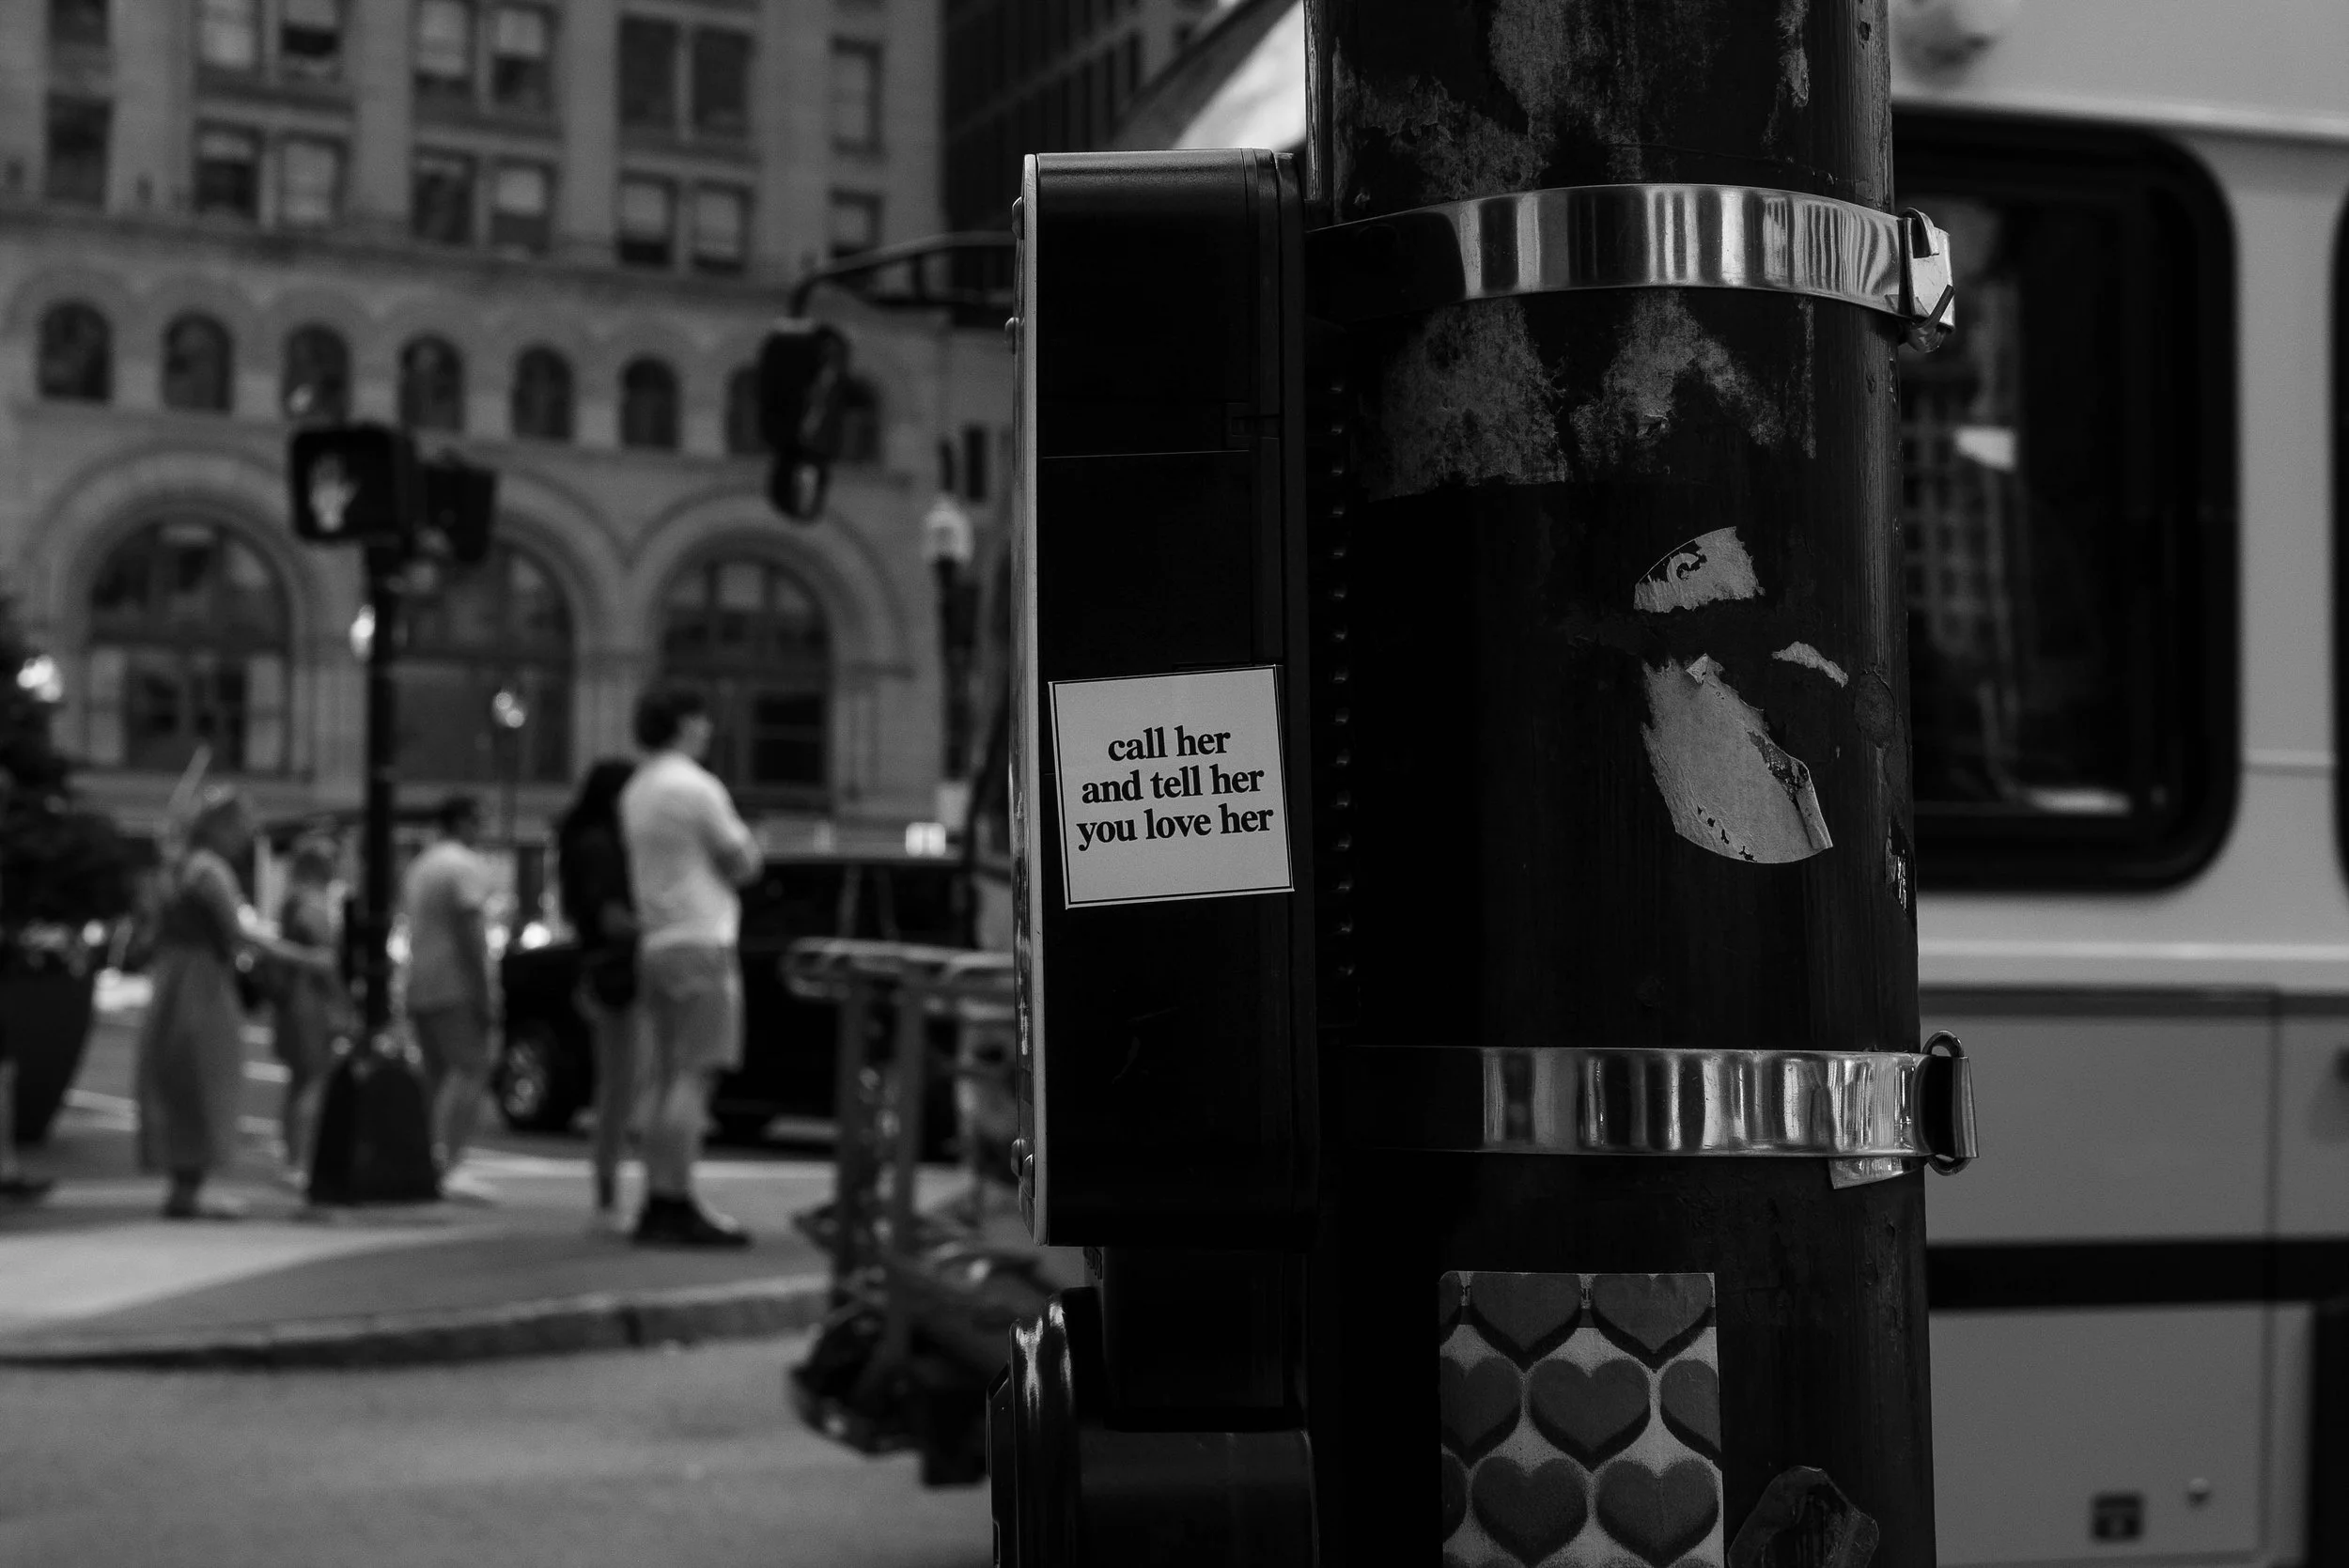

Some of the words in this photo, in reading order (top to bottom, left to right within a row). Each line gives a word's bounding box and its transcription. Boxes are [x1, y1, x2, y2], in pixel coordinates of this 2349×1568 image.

[1108, 726, 1168, 762] call
[1174, 725, 1231, 757] her
[1081, 769, 1143, 804] and
[1150, 765, 1203, 799] tell
[1209, 764, 1265, 795] her
[1076, 819, 1138, 851] you
[1143, 808, 1211, 839] love
[1219, 803, 1274, 834] her
